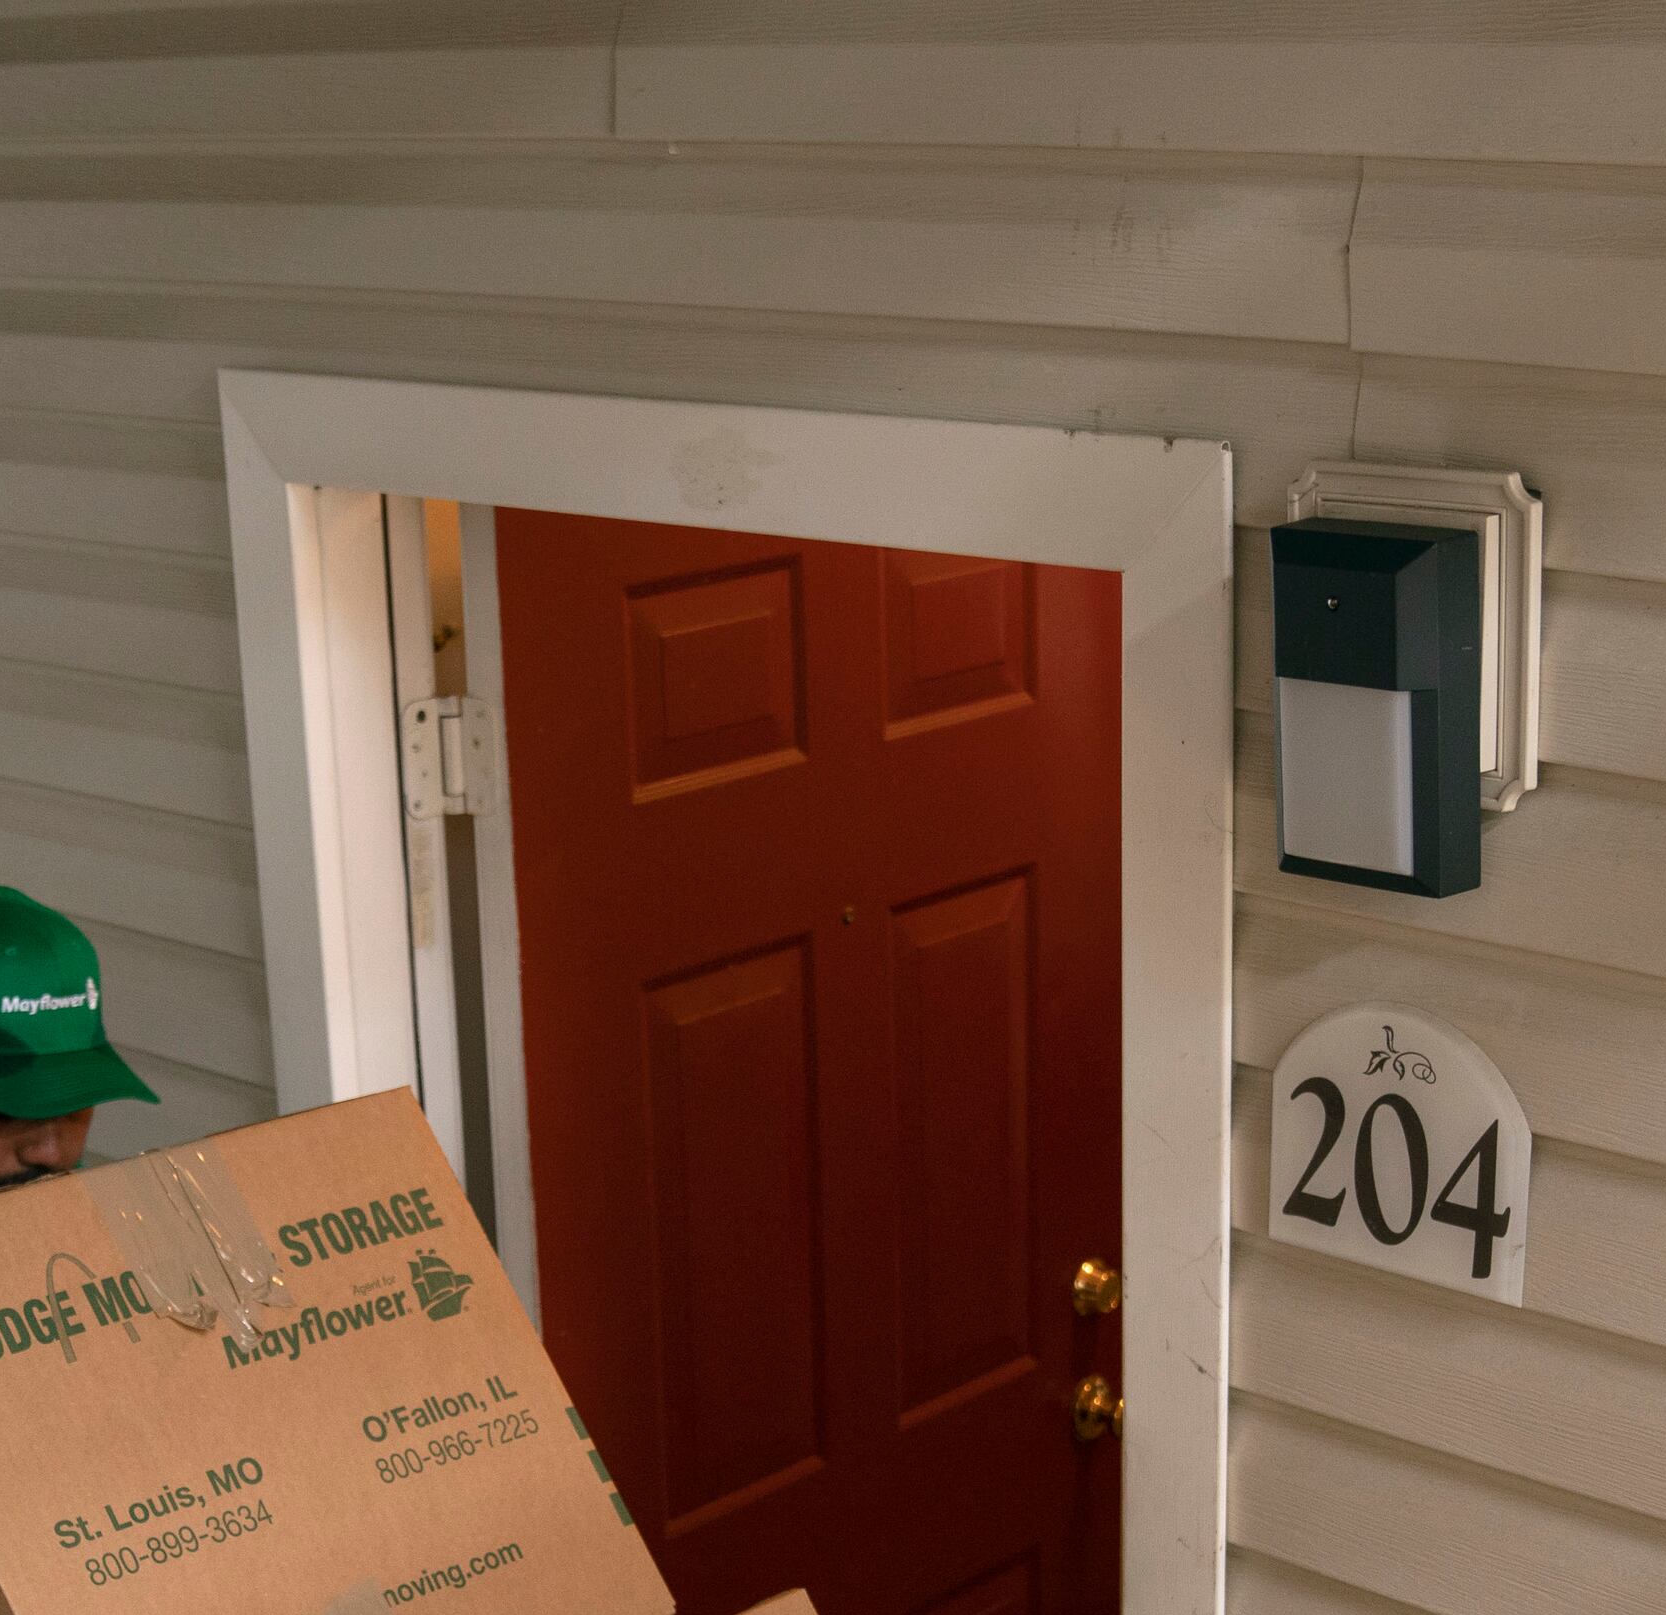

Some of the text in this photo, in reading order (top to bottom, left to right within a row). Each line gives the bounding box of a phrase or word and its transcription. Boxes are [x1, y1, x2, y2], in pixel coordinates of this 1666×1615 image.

[1, 993, 87, 1015] Mayflower
[1282, 1076, 1511, 1279] 204
[277, 1187, 443, 1268] STORAGE
[352, 1274, 397, 1297] Agent for
[221, 1290, 408, 1370] Mayflower
[362, 1374, 517, 1446] O'Fallon, IL
[374, 1409, 540, 1486] 800-966-7225
[54, 1456, 264, 1551] St. Louis, MO
[84, 1498, 275, 1588] 800-899-3634
